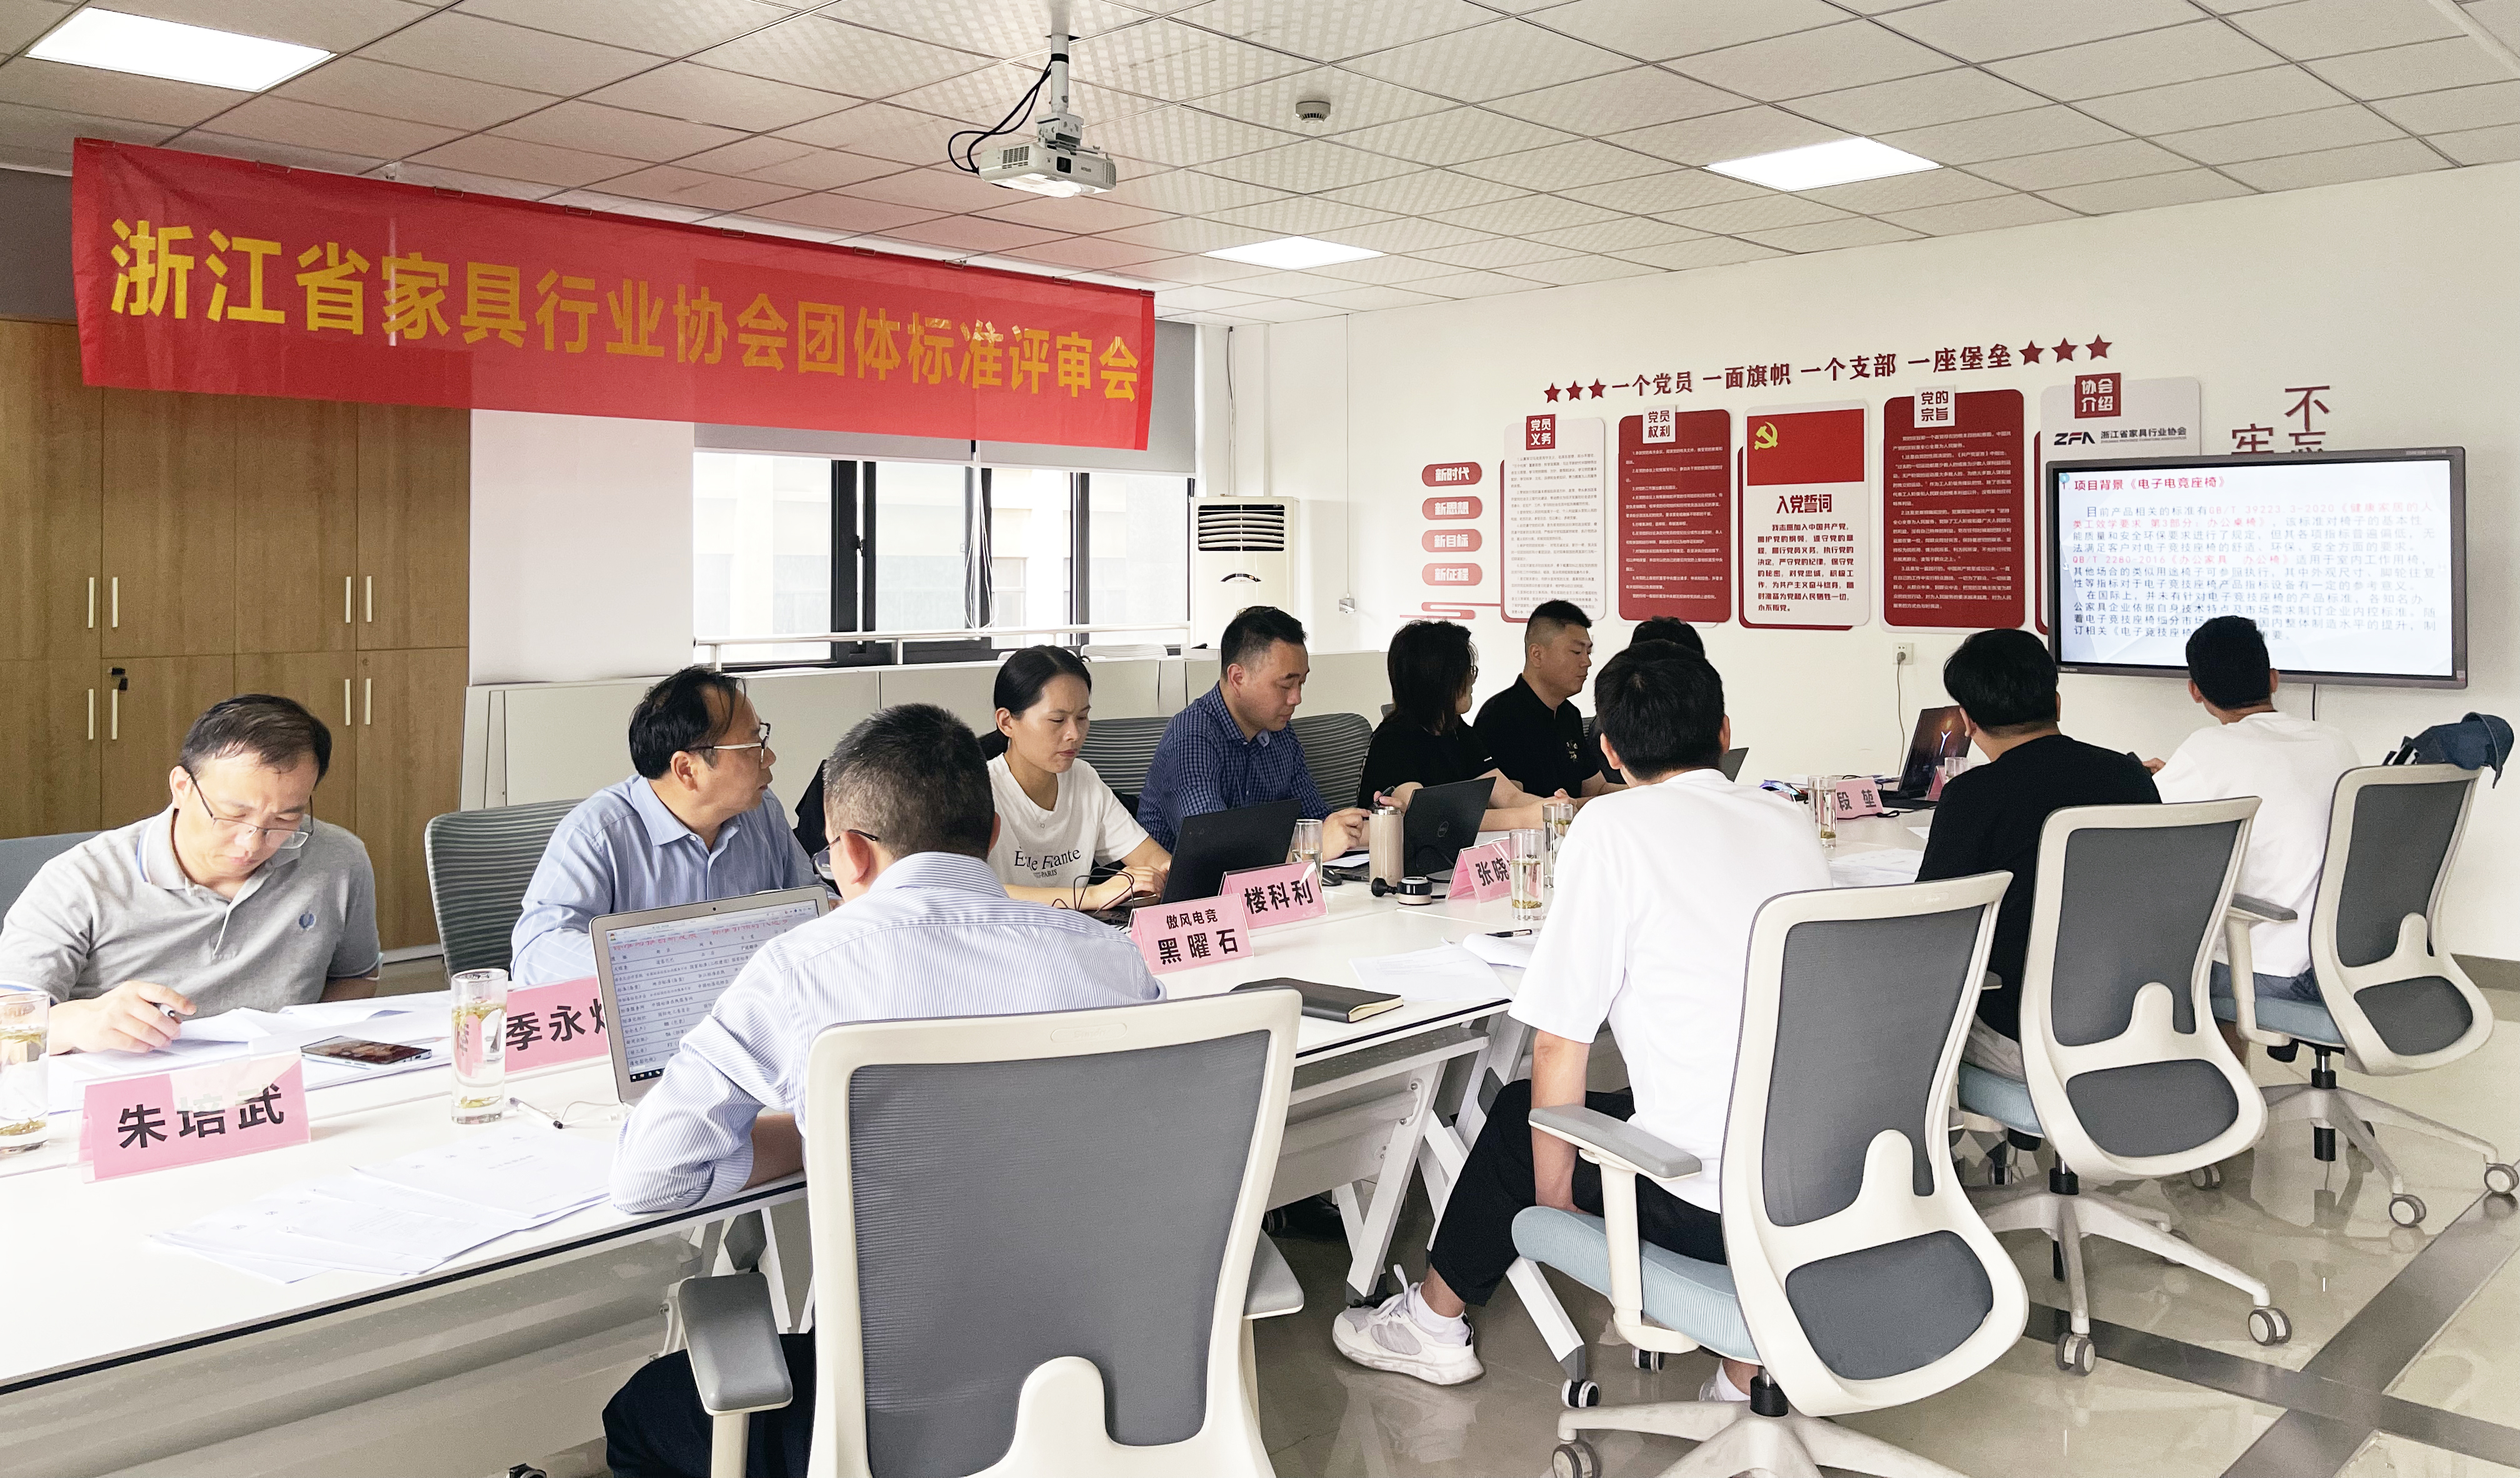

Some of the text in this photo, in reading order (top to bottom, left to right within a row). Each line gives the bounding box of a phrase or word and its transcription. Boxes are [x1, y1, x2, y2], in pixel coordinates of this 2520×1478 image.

[110, 218, 1139, 402] 浙江省家具行业协会团体标准评审会
[1612, 343, 2012, 396] 一个党员 一面旗帜 一个支部 一座堡垒
[2081, 378, 2114, 395] 协会
[1921, 390, 1949, 405] 党的
[2081, 396, 2114, 413] 介绍
[1648, 410, 1671, 424] 党员
[1921, 407, 1949, 422] 宗旨
[1530, 418, 1552, 431] 党员
[1648, 425, 1671, 438] 权利
[1530, 432, 1552, 446] 义务
[2100, 426, 2187, 440] 浙江省家具行业协会
[1435, 467, 1470, 482] 新时代
[2074, 476, 2226, 491] 项目背景《电子电竞座椅》
[1434, 501, 1469, 516] 新思想
[1776, 494, 1832, 514] 入党誓词
[1434, 534, 1469, 548] 新目标
[1434, 567, 1469, 581] 新征程
[1475, 857, 1510, 886] 张晓
[1244, 879, 1314, 915] 楼科利
[1166, 908, 1218, 930] 傲风电竞
[1158, 928, 1239, 965] 黑曜石
[118, 1083, 285, 1149] 朱培武
